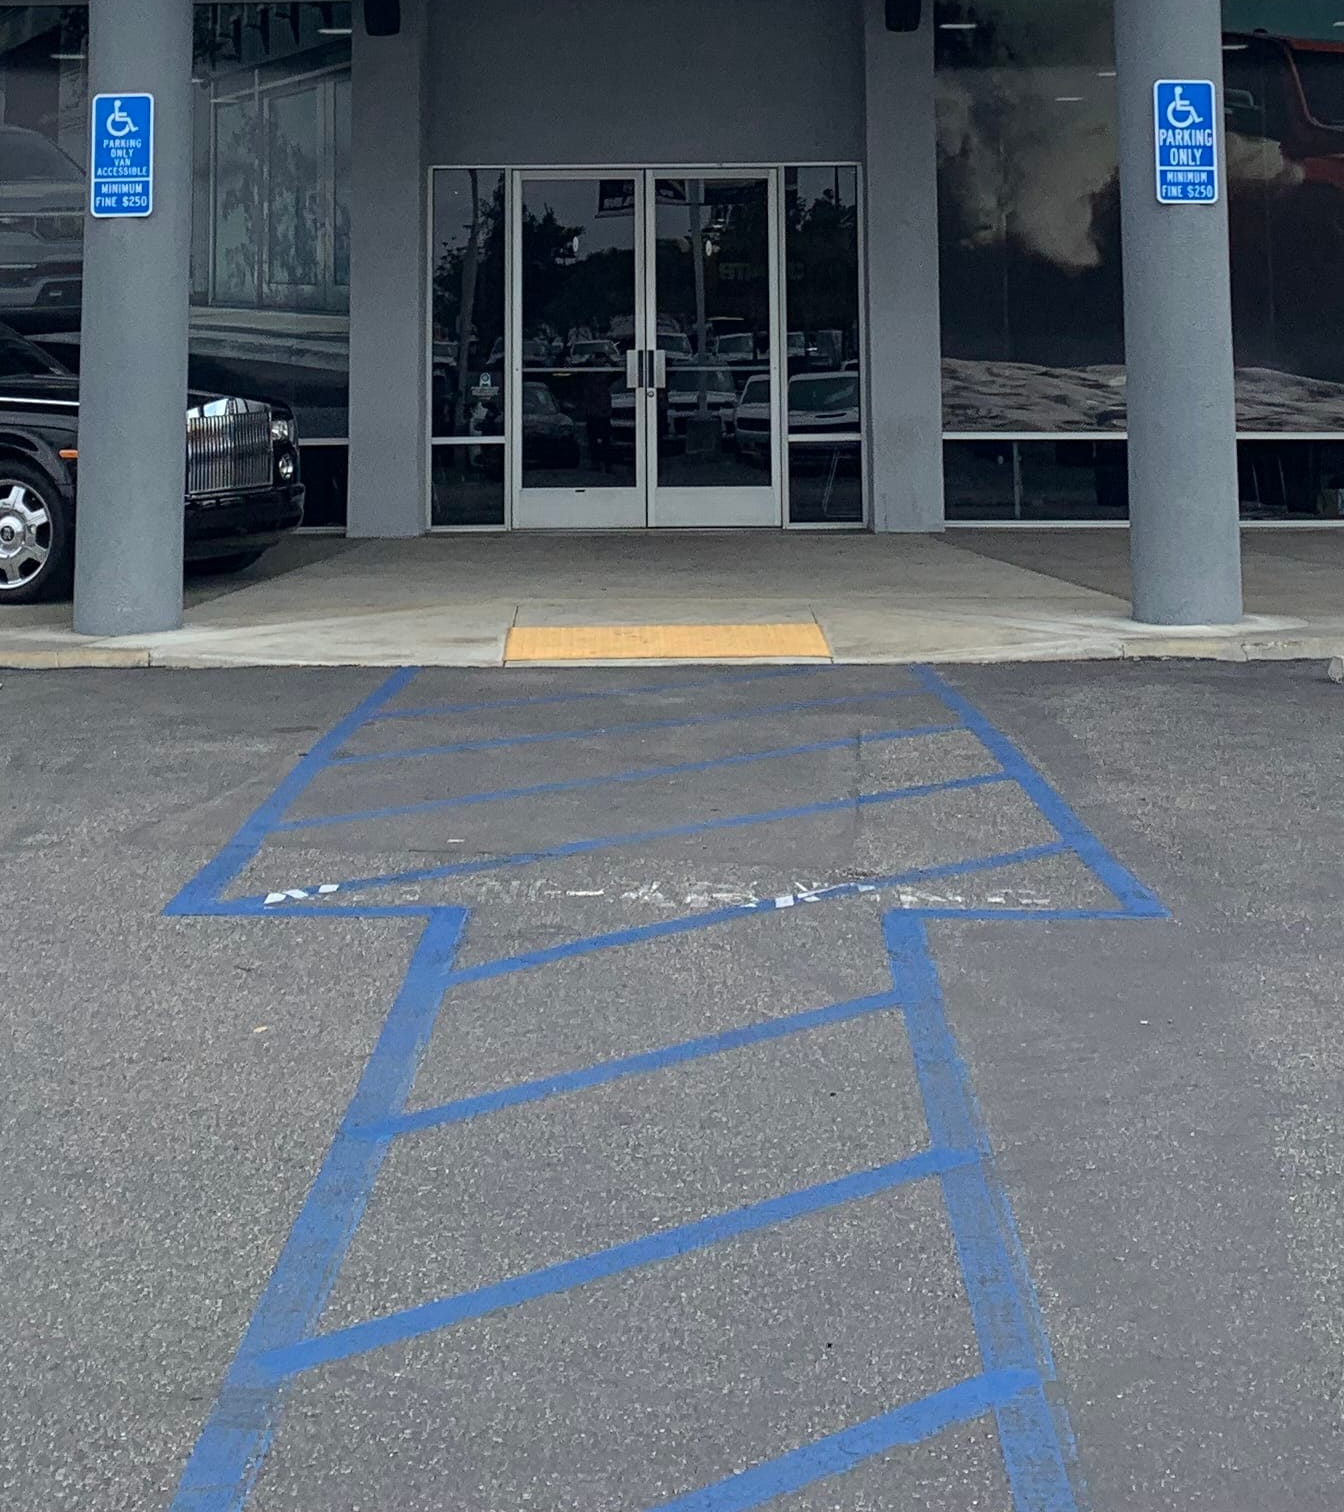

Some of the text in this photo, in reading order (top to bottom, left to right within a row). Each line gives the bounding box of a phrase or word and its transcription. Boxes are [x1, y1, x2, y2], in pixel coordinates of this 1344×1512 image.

[1159, 129, 1213, 147] PARKING
[103, 139, 142, 149] PARKING
[110, 148, 134, 158] ONLY
[1169, 148, 1203, 166] ONLY
[114, 158, 131, 167] VAN
[96, 166, 148, 176] ACCESSIBLE
[1166, 171, 1208, 183] MINIMUM
[101, 183, 143, 194] MINIMUM
[1162, 185, 1213, 198] FINE $250
[96, 196, 148, 207] FINE $250
